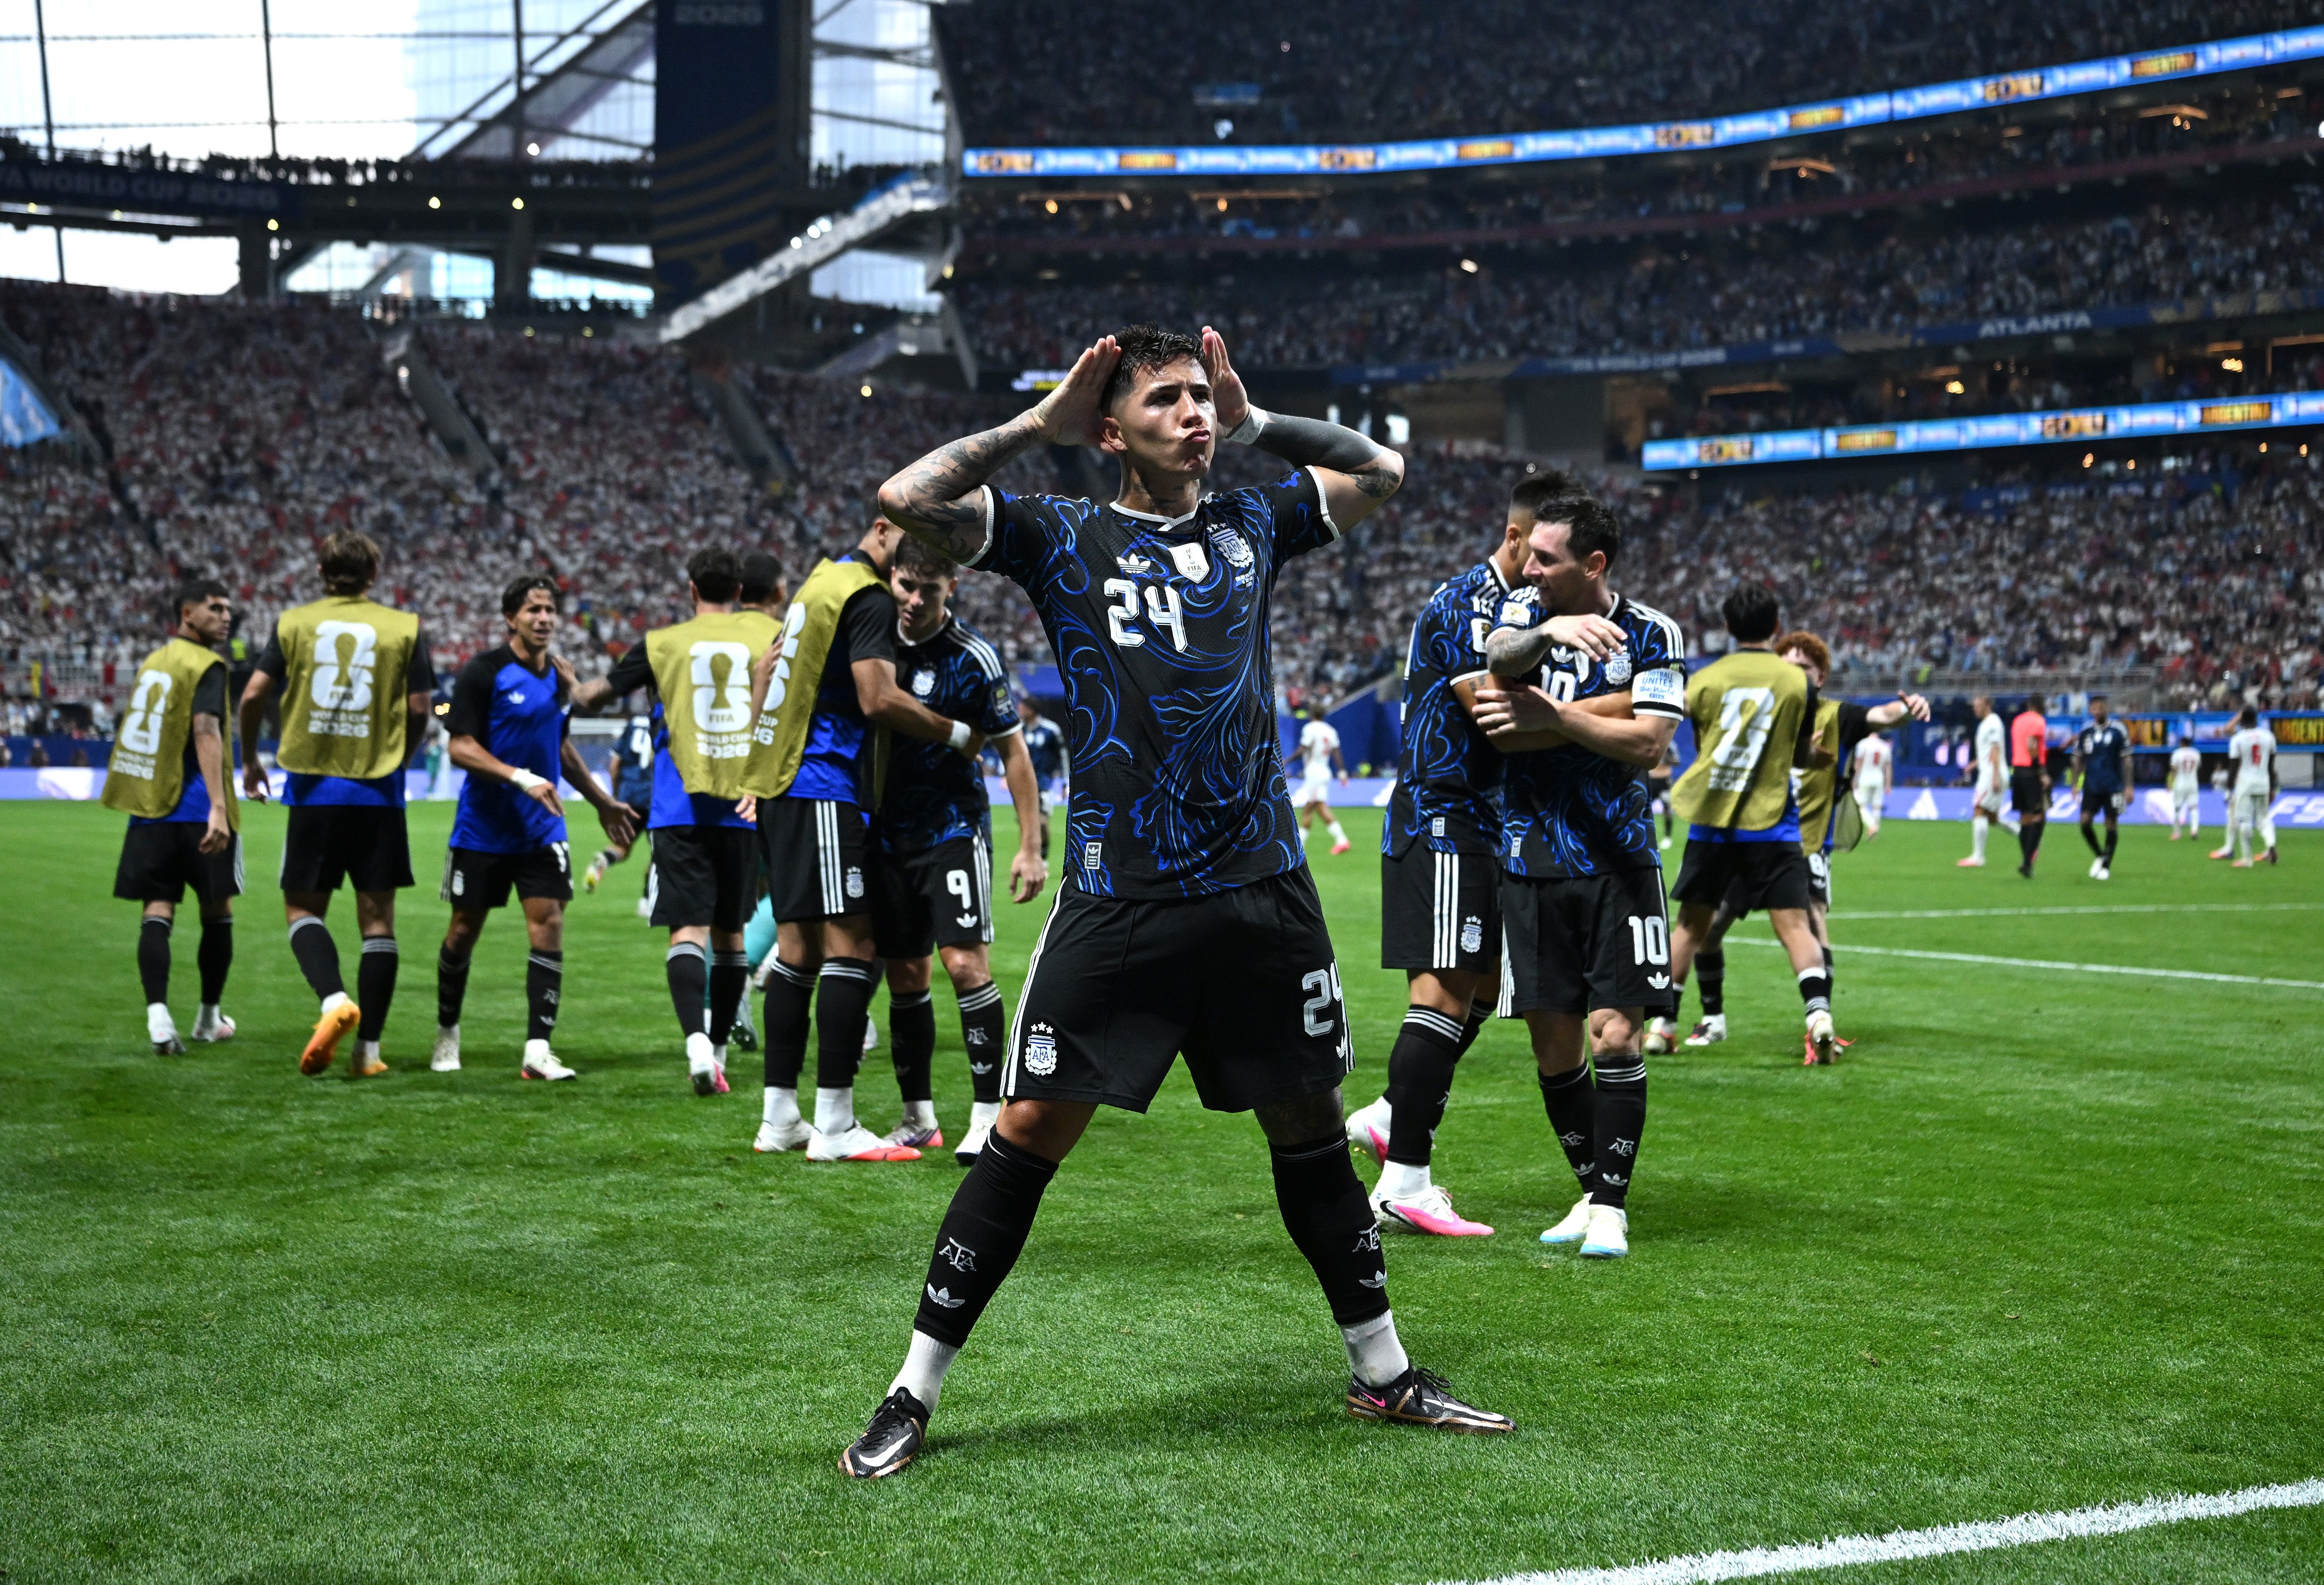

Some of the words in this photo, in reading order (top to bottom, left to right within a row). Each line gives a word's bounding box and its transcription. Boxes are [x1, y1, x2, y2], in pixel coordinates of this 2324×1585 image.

[29, 170, 127, 197] WORLD
[130, 180, 184, 201] CUP
[1979, 311, 2092, 337] ATLANTA
[1104, 578, 1188, 652] 24
[1642, 677, 1673, 688] UNITES
[708, 716, 735, 724] FIFA
[696, 733, 730, 744] WORLD
[732, 734, 752, 743] CUP
[697, 743, 750, 759] 2026
[946, 869, 972, 909] 9
[1628, 916, 1669, 966] 10
[1302, 958, 1345, 1037] 24
[1032, 1045, 1050, 1064] AFA
[1608, 1137, 1635, 1157] AFA
[1352, 1223, 1380, 1253] AFA
[938, 1237, 977, 1272] AFA
